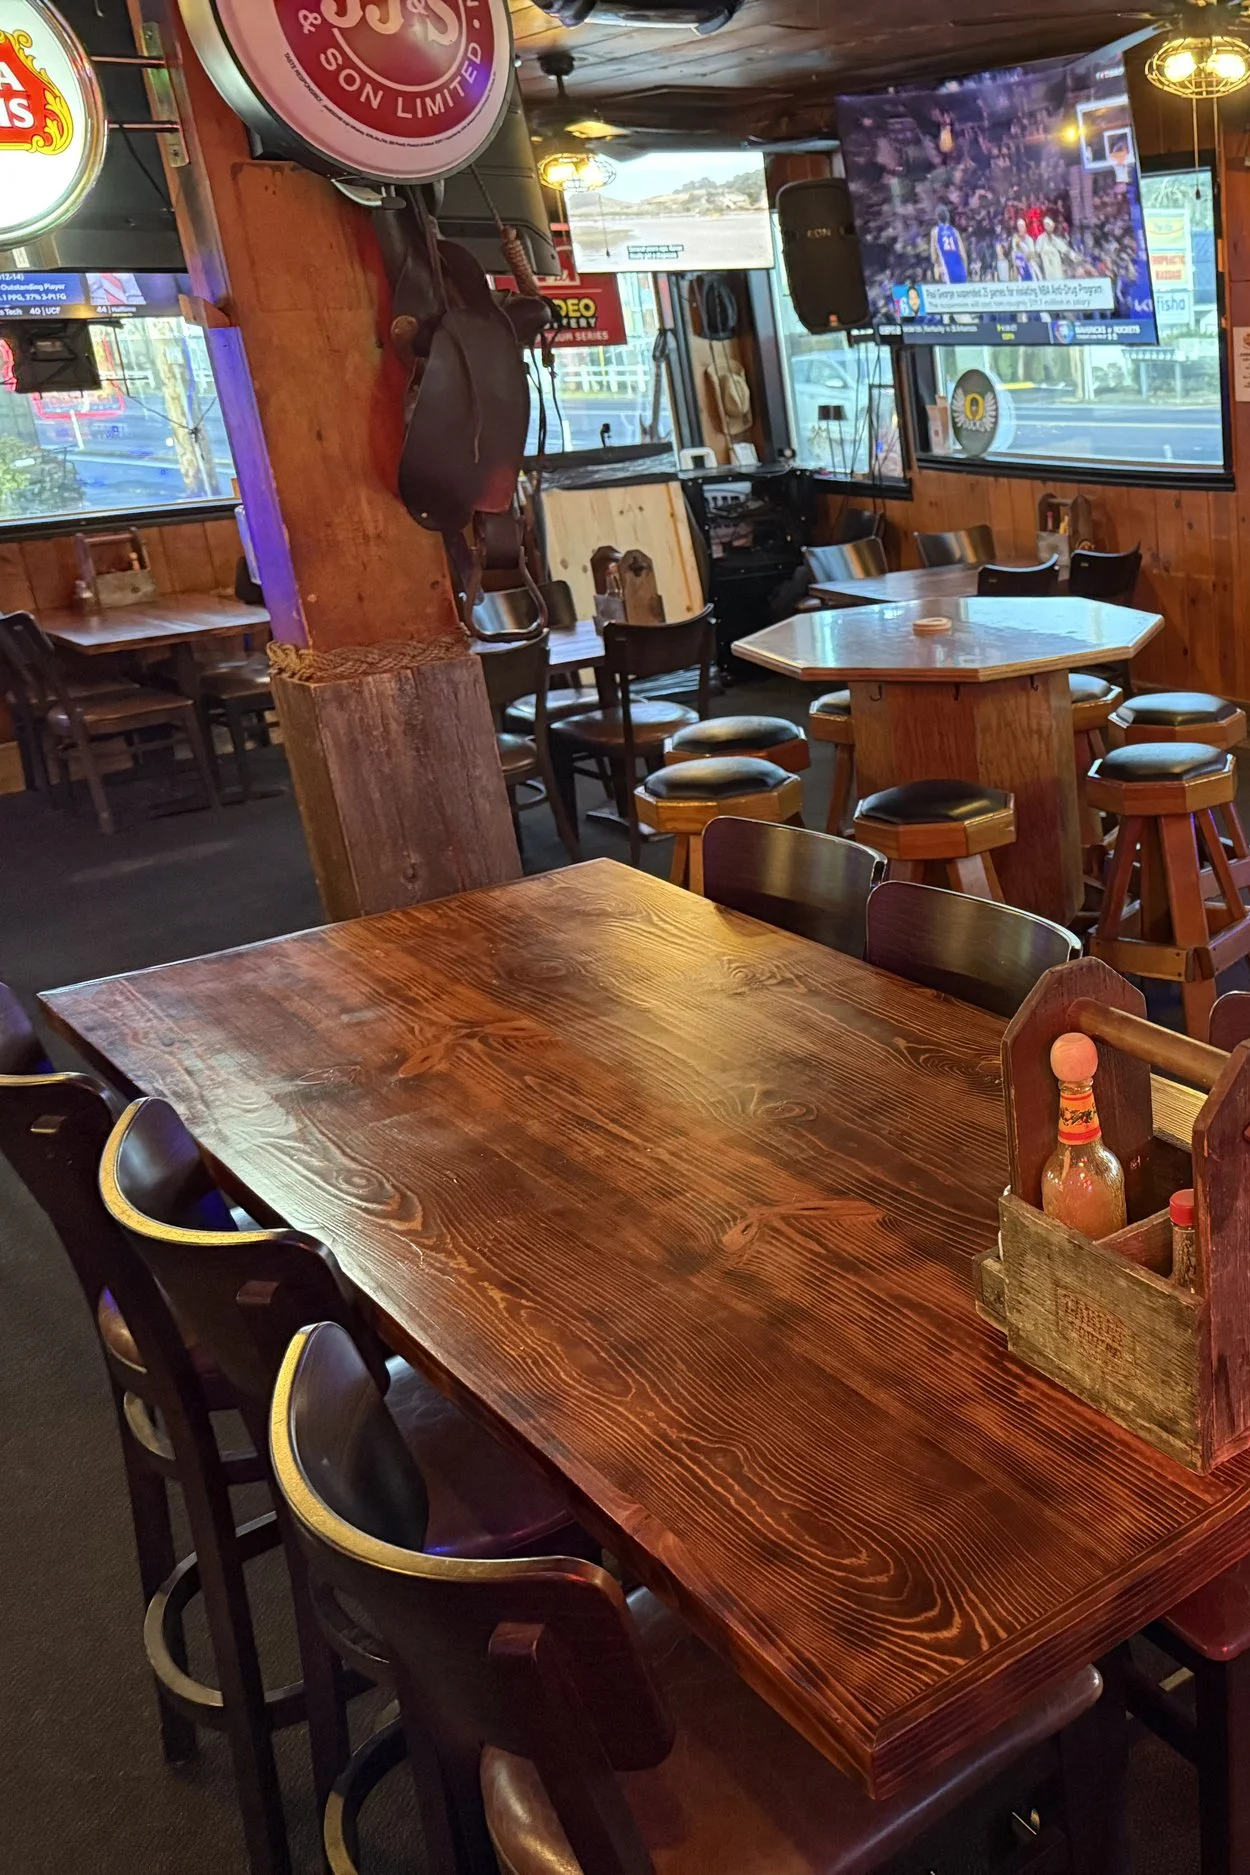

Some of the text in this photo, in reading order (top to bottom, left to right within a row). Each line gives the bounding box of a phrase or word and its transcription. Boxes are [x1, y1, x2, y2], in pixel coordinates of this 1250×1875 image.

[320, 48, 384, 110] SON
[397, 42, 482, 119] LIMITED
[1, 283, 65, 292] Outstanding Player
[552, 298, 596, 317] DEO
[575, 330, 609, 340] SERIES
